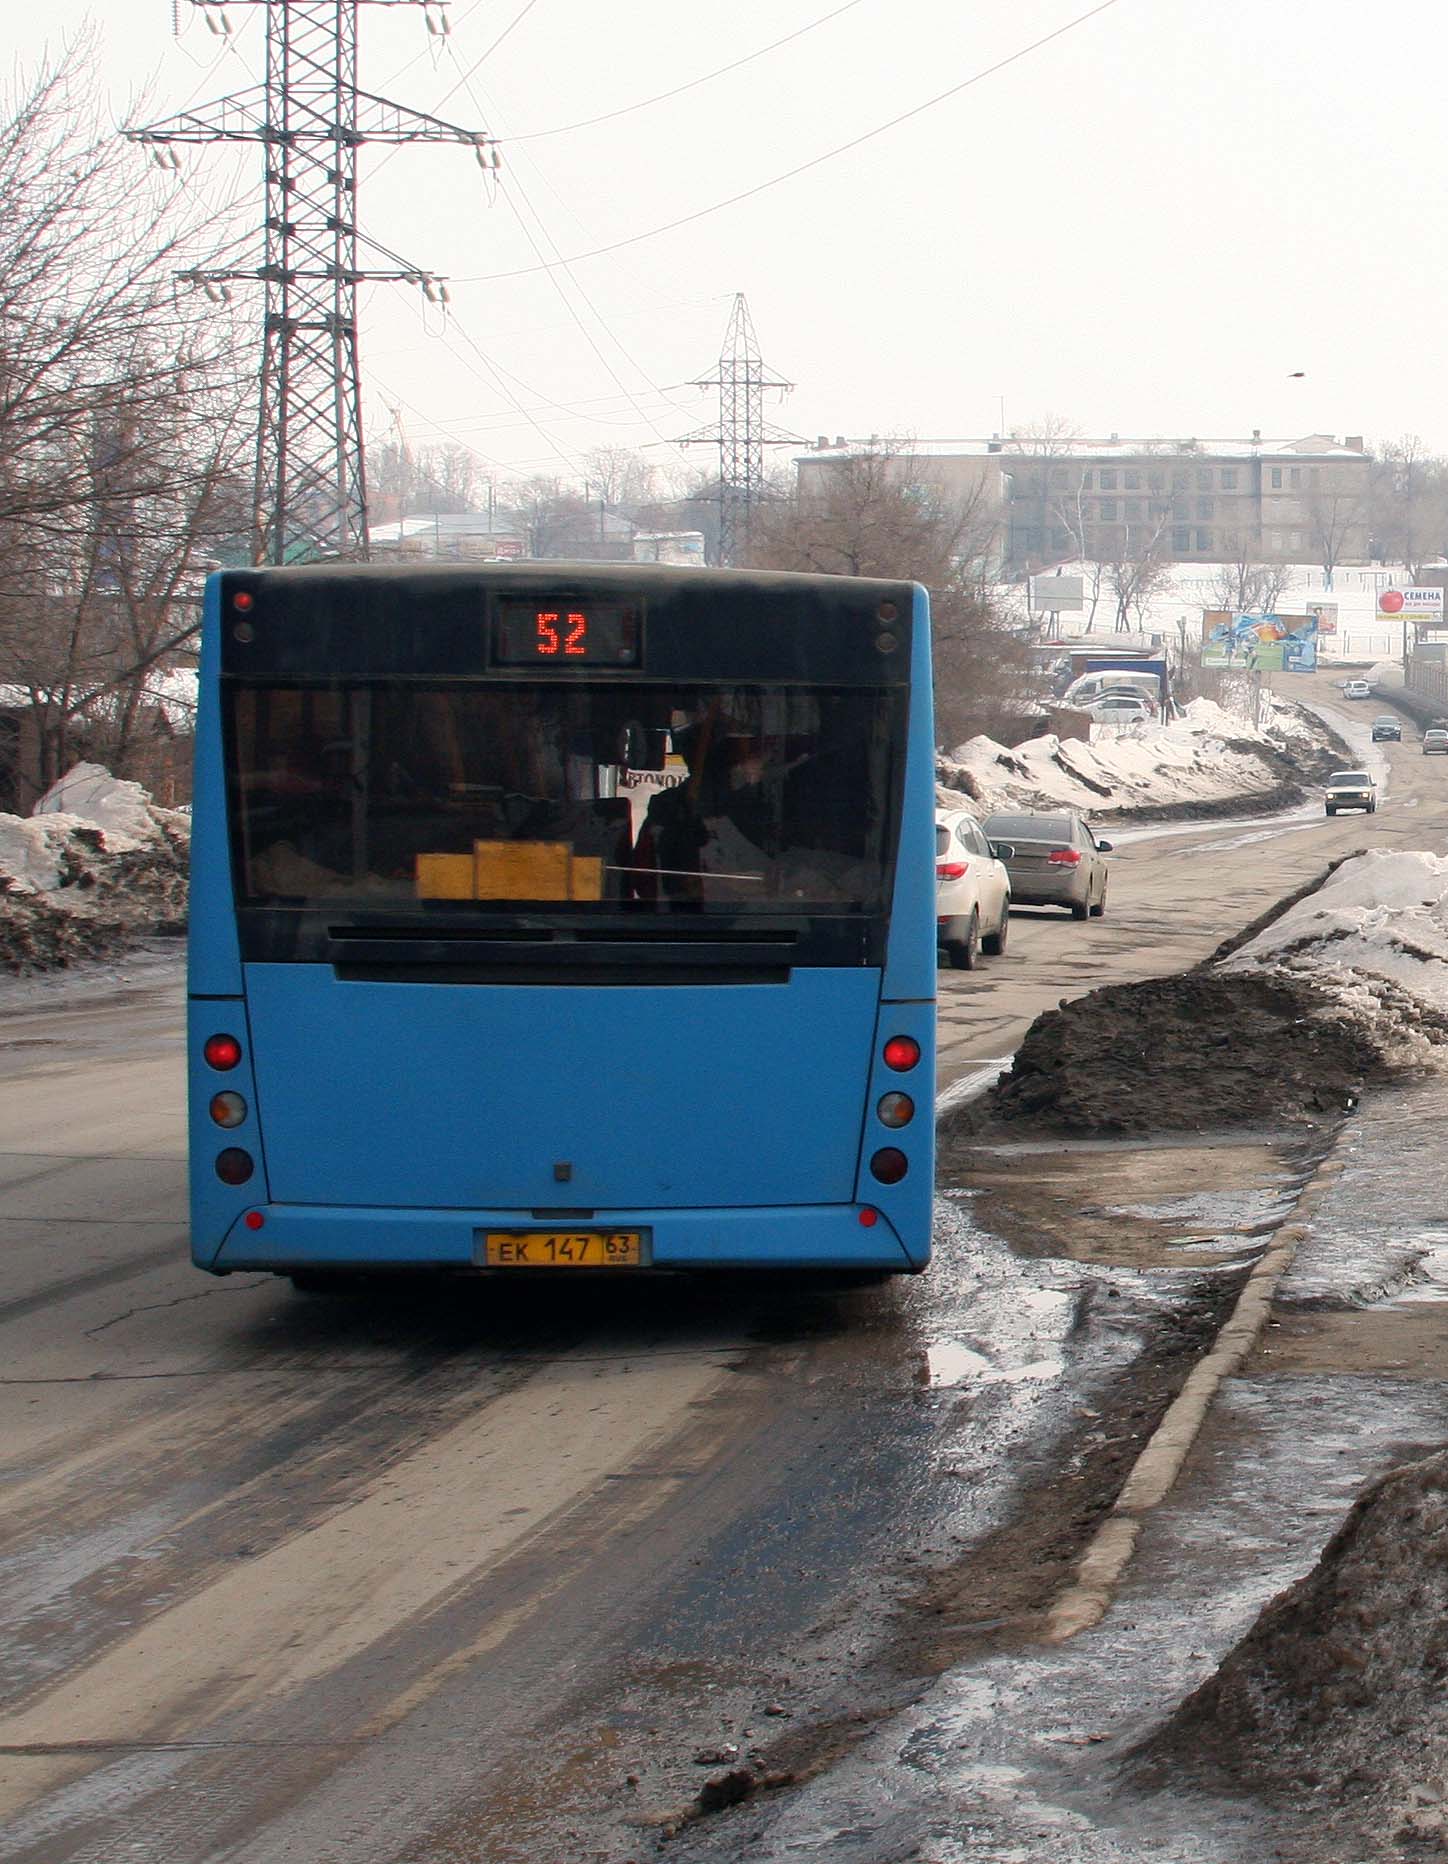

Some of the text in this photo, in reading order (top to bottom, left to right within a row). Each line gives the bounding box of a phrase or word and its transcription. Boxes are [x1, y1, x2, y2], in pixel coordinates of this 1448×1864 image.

[1404, 591, 1441, 601] СЕМЕНА
[537, 613, 586, 654] 52
[500, 1236, 630, 1261] ЕК 147 63
